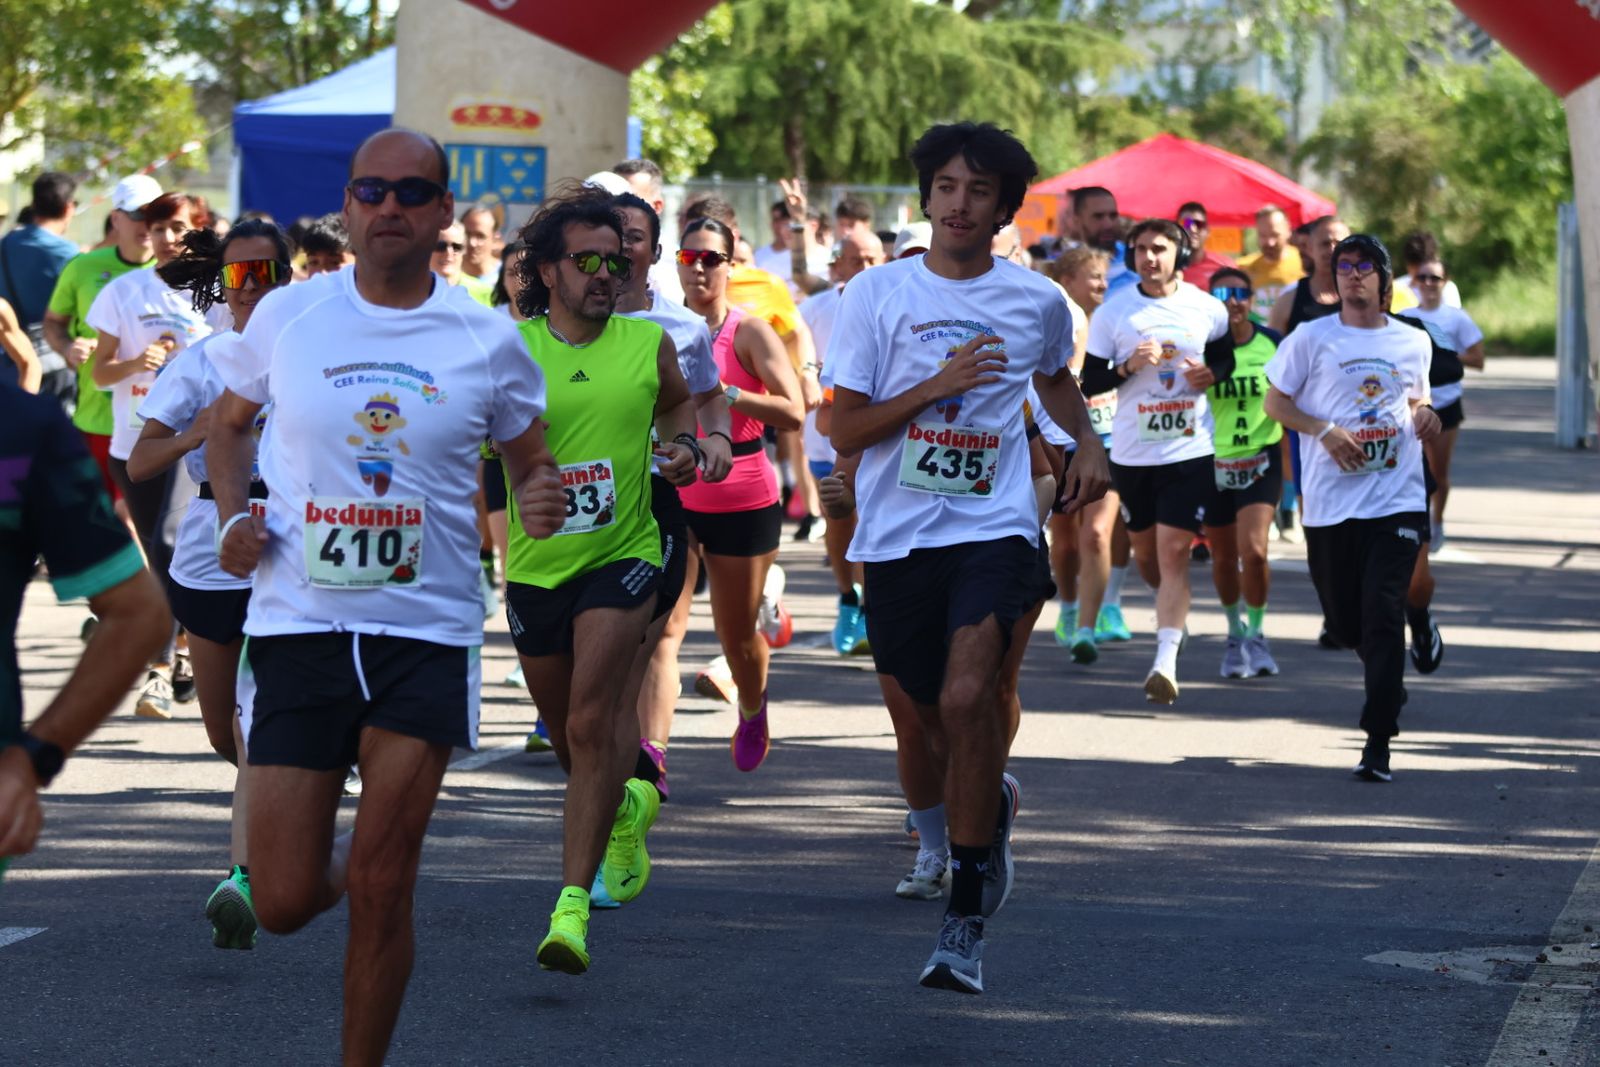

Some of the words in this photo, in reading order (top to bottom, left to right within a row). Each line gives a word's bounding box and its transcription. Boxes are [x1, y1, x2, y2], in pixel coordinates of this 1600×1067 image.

[920, 331, 937, 342] CEE
[938, 330, 963, 338] Reina
[334, 375, 355, 388] CEE
[358, 374, 390, 384] Reina
[1137, 400, 1195, 414] bedunia
[1147, 411, 1187, 432] 406
[907, 422, 1000, 449] bedunia
[1355, 427, 1397, 441] dunia
[1363, 439, 1390, 462] 07
[916, 446, 985, 480] 435
[560, 464, 611, 487] unia
[305, 501, 422, 527] bedunia
[319, 527, 402, 568] 410
